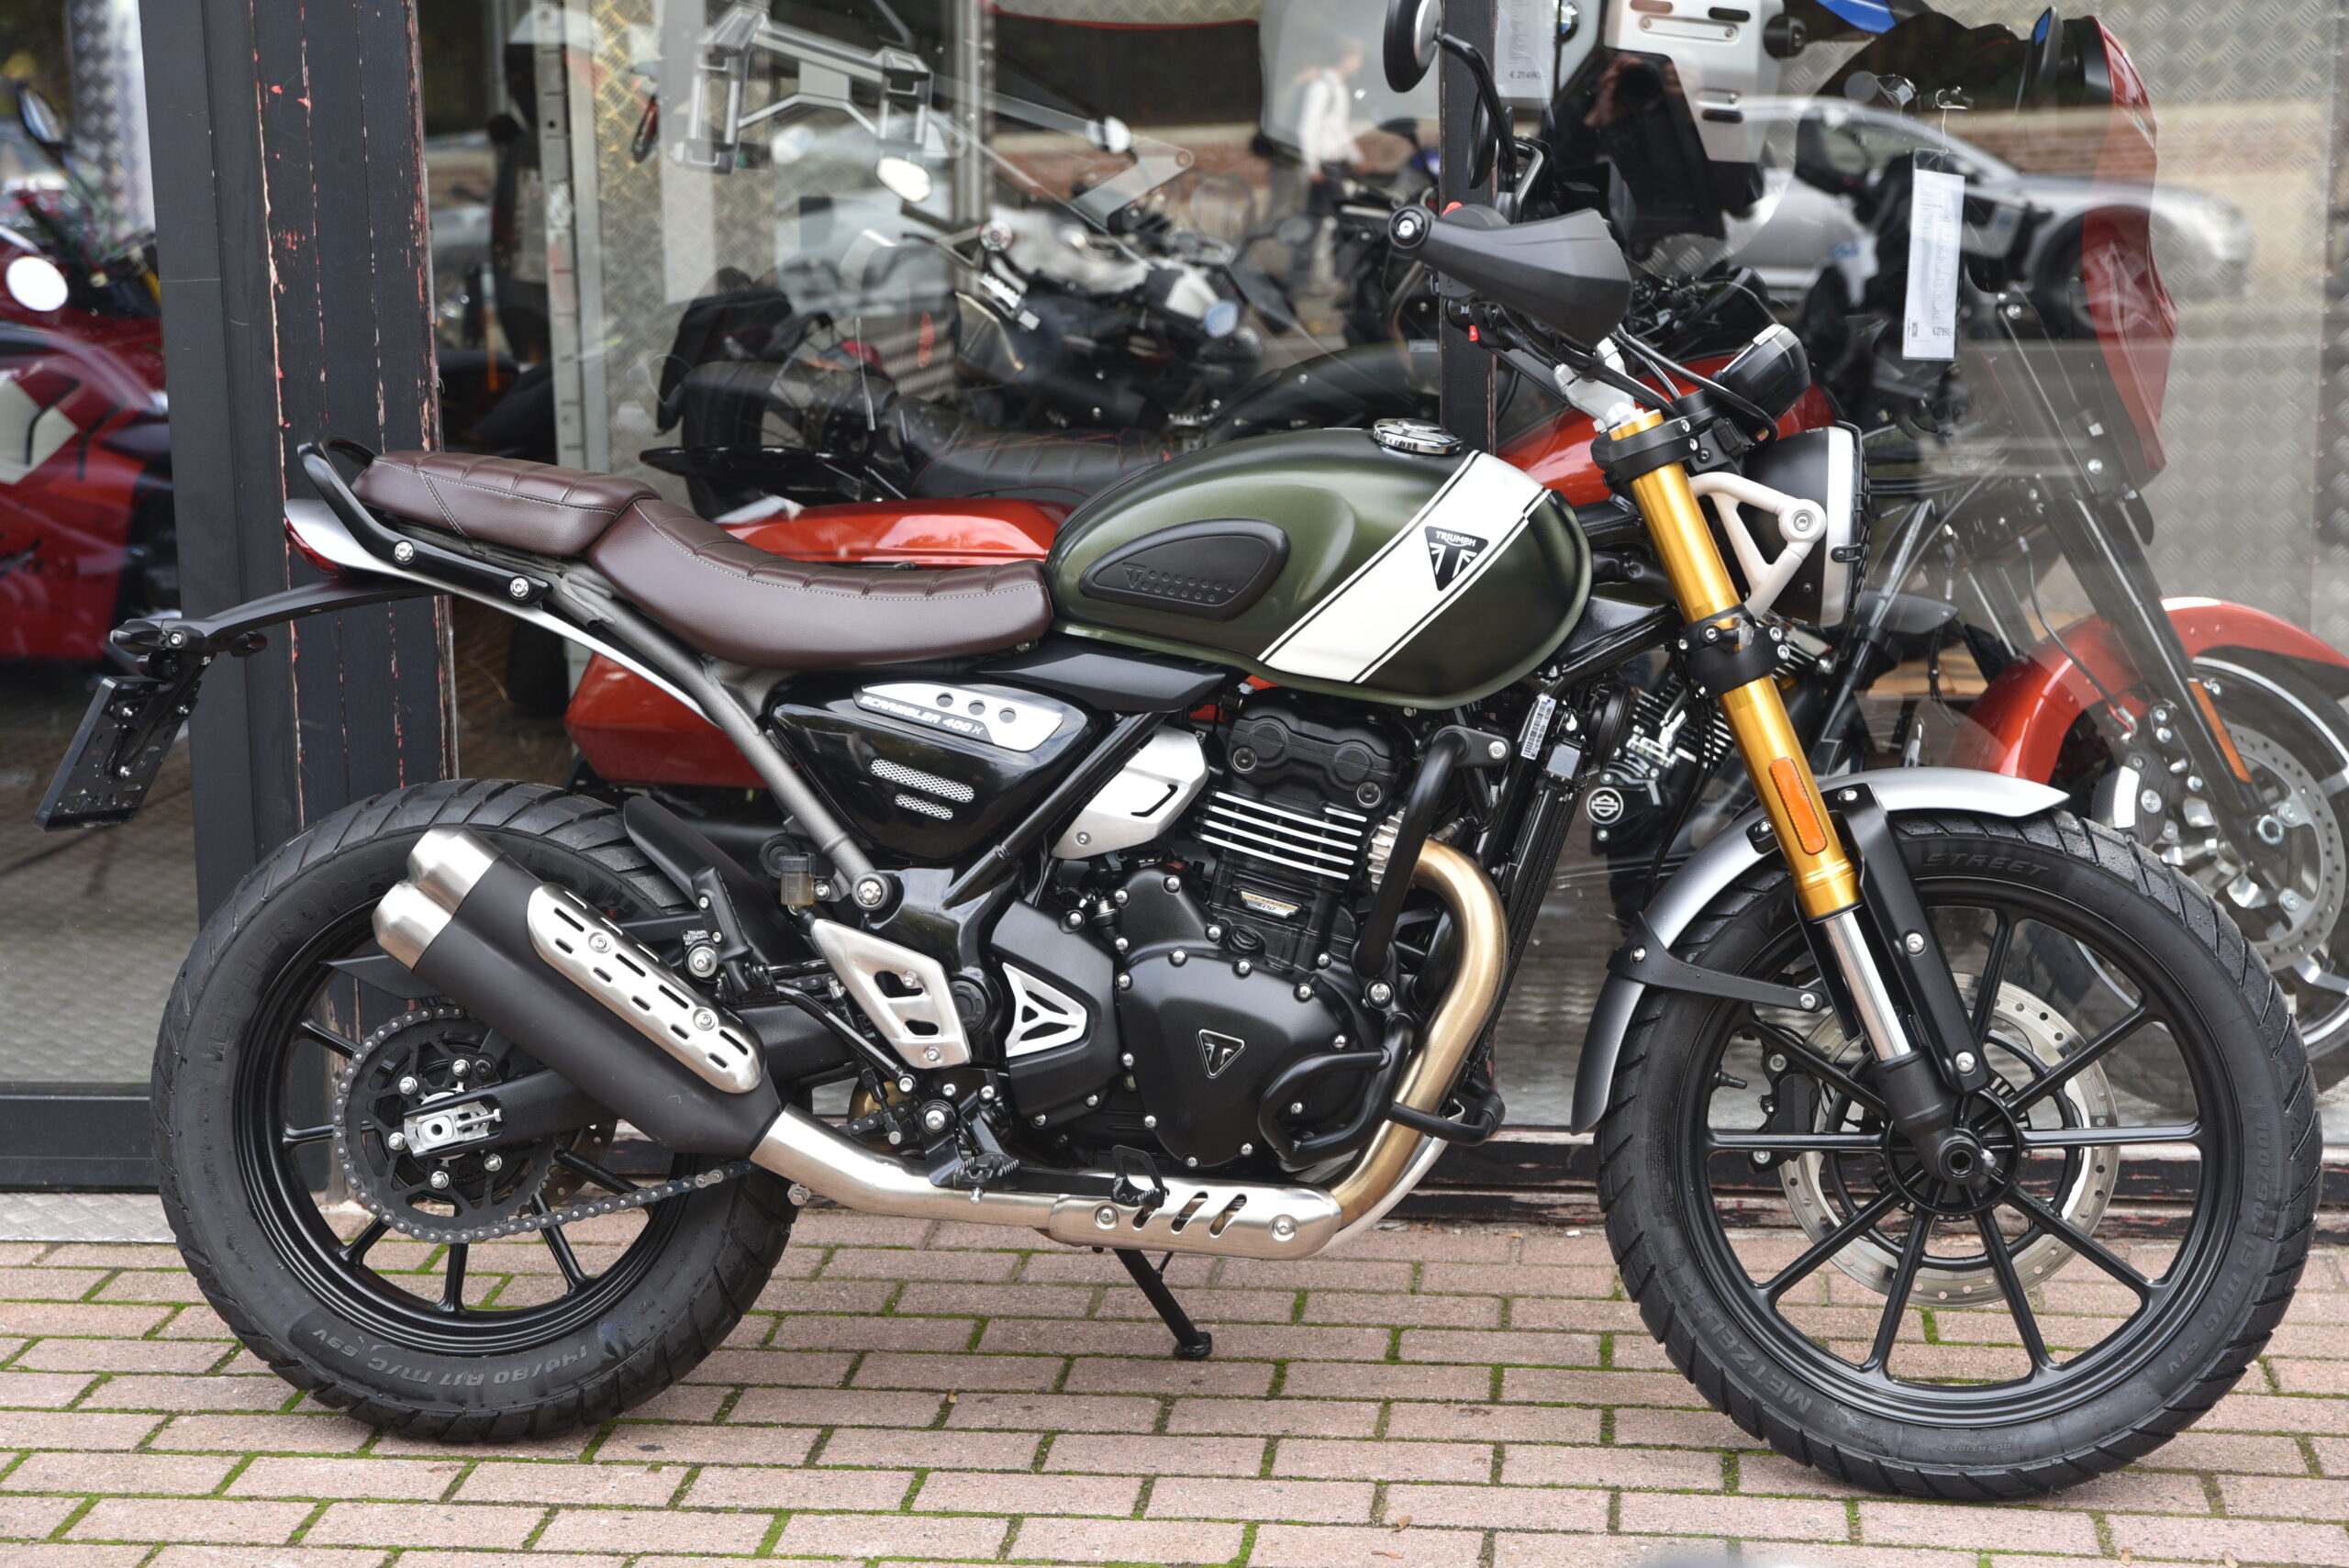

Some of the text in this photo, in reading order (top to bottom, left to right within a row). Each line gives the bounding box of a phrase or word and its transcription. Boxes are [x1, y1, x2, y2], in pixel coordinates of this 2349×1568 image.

[1436, 530, 1476, 547] TRIUMPH
[859, 695, 985, 735] SCRAMBLER 400 X
[1923, 852, 2051, 876] STREET
[1256, 902, 1276, 911] 400
[199, 917, 297, 1071] METZELER
[1682, 1272, 1815, 1416] METZELER
[367, 1357, 433, 1384] M/C
[493, 1344, 588, 1385] 140/80
[439, 1372, 485, 1387] R17
[1948, 1441, 2012, 1453] ROTATION
